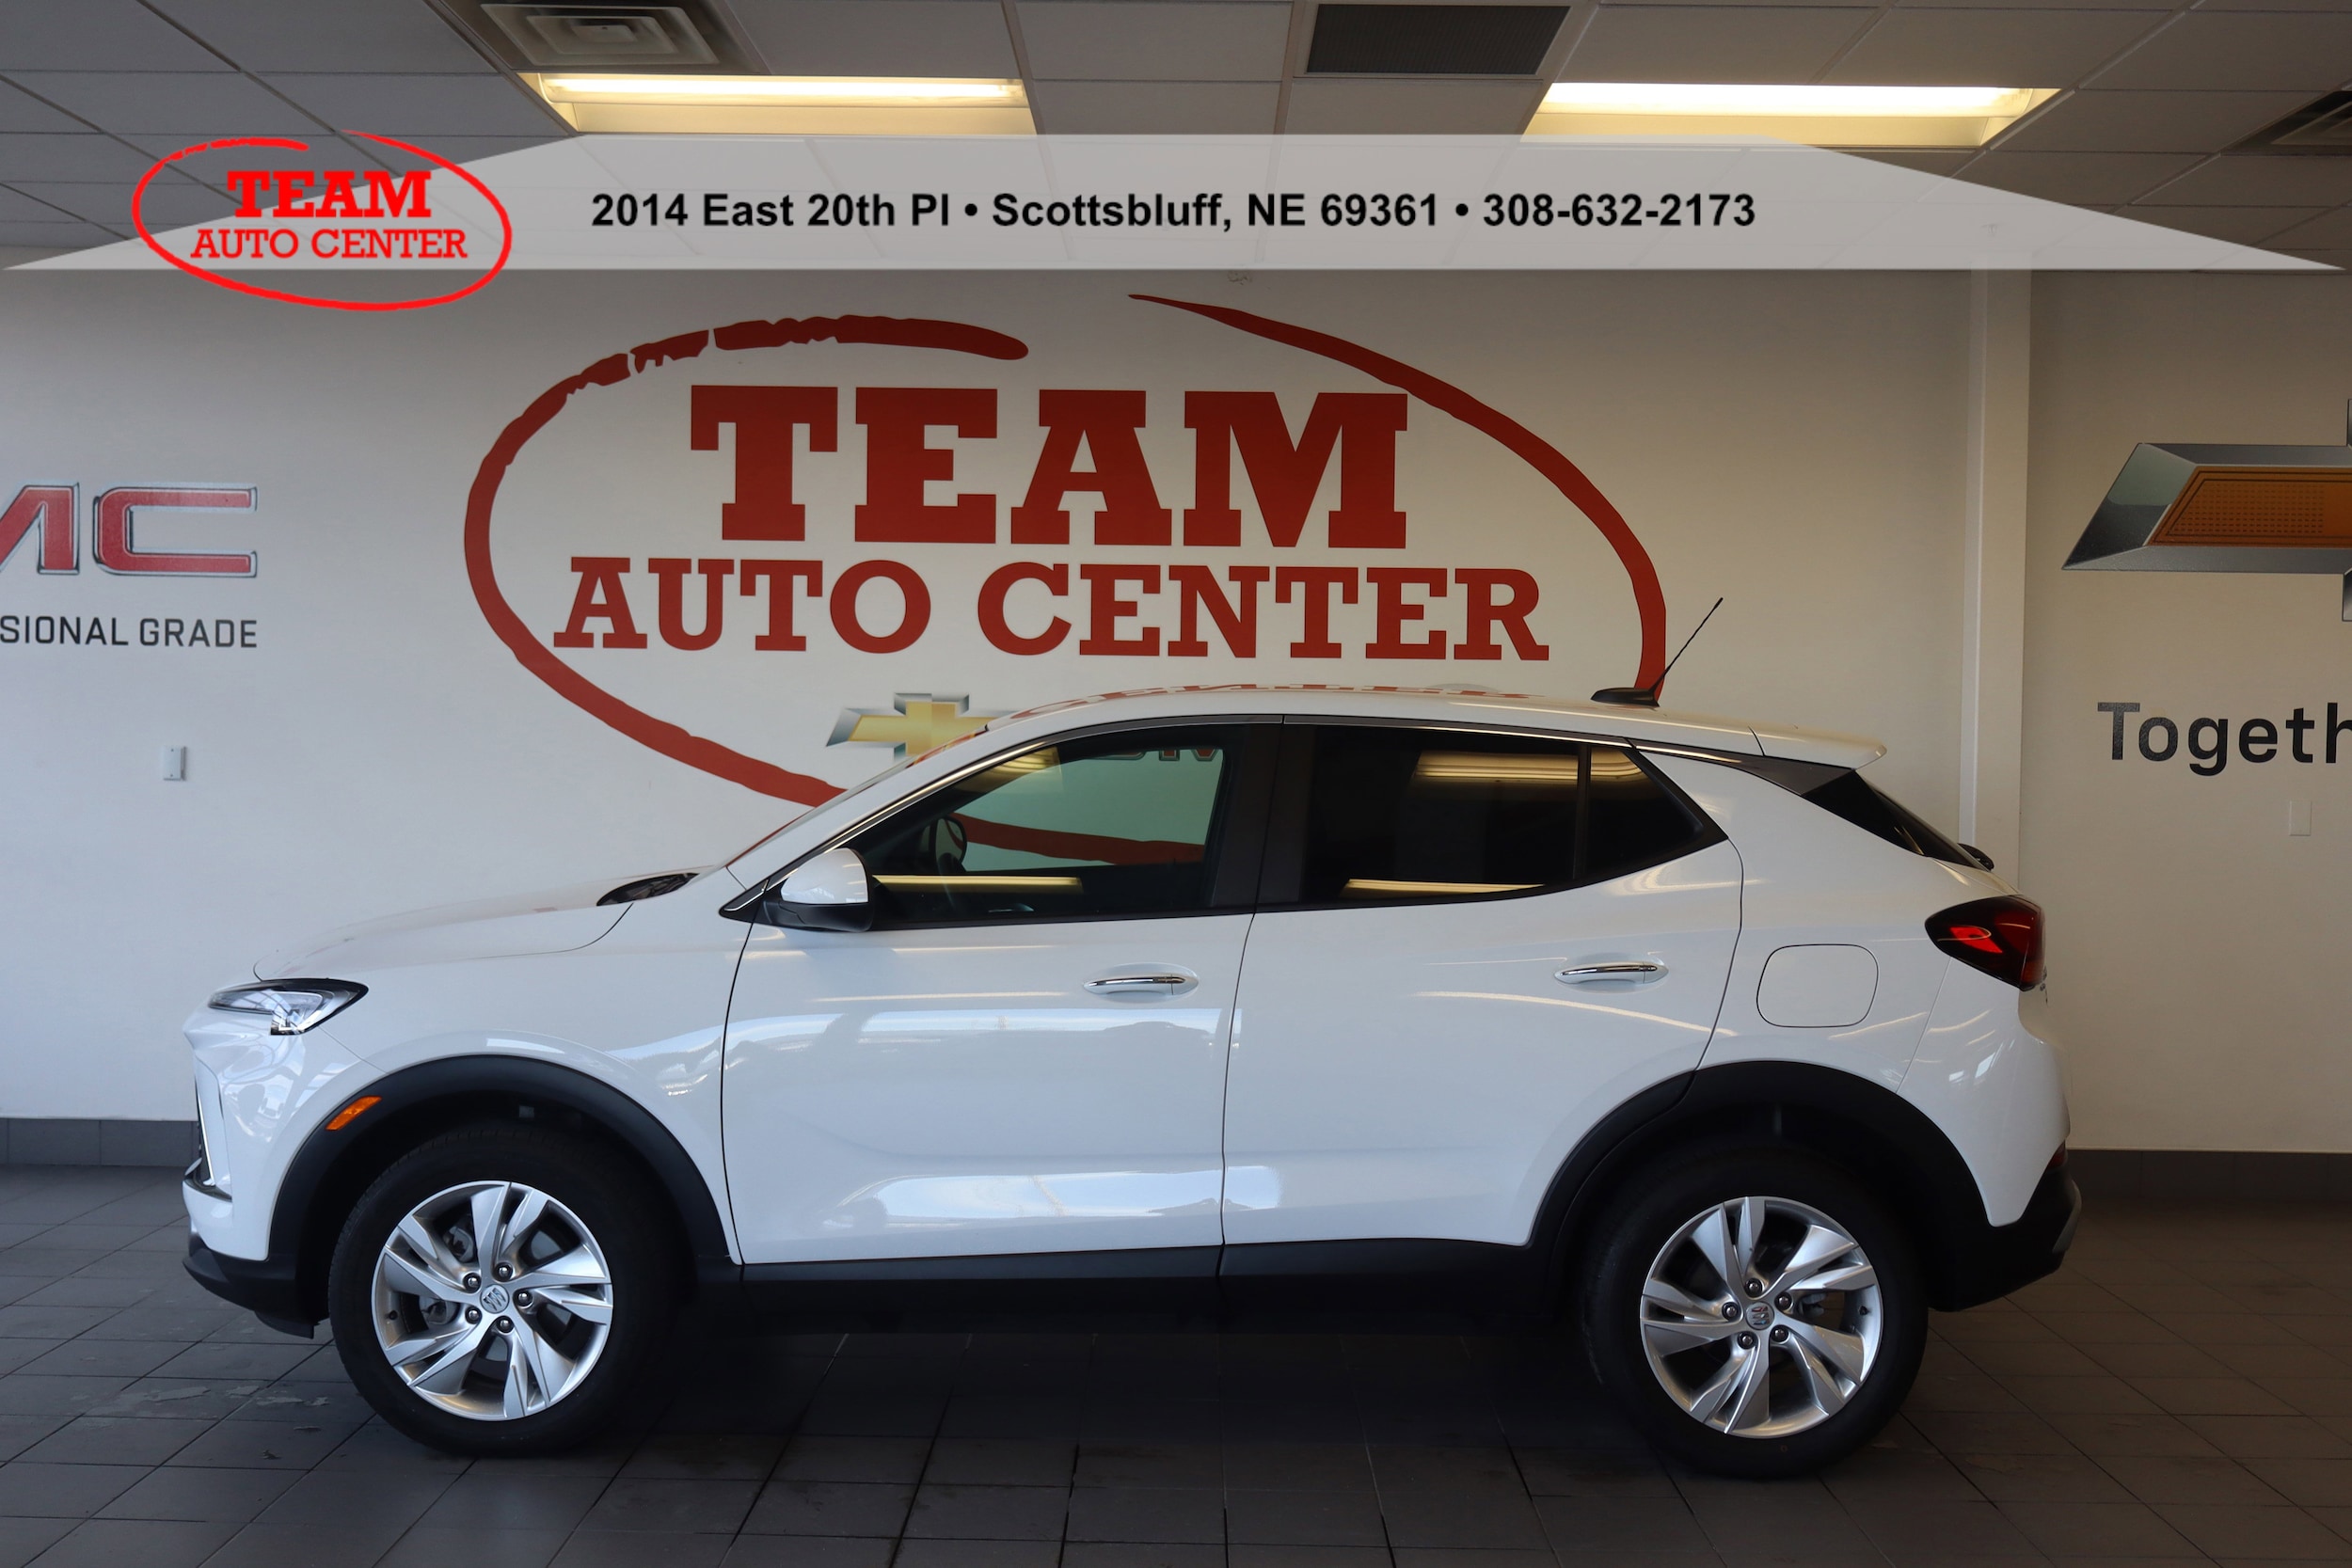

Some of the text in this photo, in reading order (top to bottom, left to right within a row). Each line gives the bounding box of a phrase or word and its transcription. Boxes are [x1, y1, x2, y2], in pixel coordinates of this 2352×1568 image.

[691, 385, 1408, 549] TEAM
[0, 615, 258, 648] SIONAL GRADE
[553, 556, 1550, 662] AUTO CENTER
